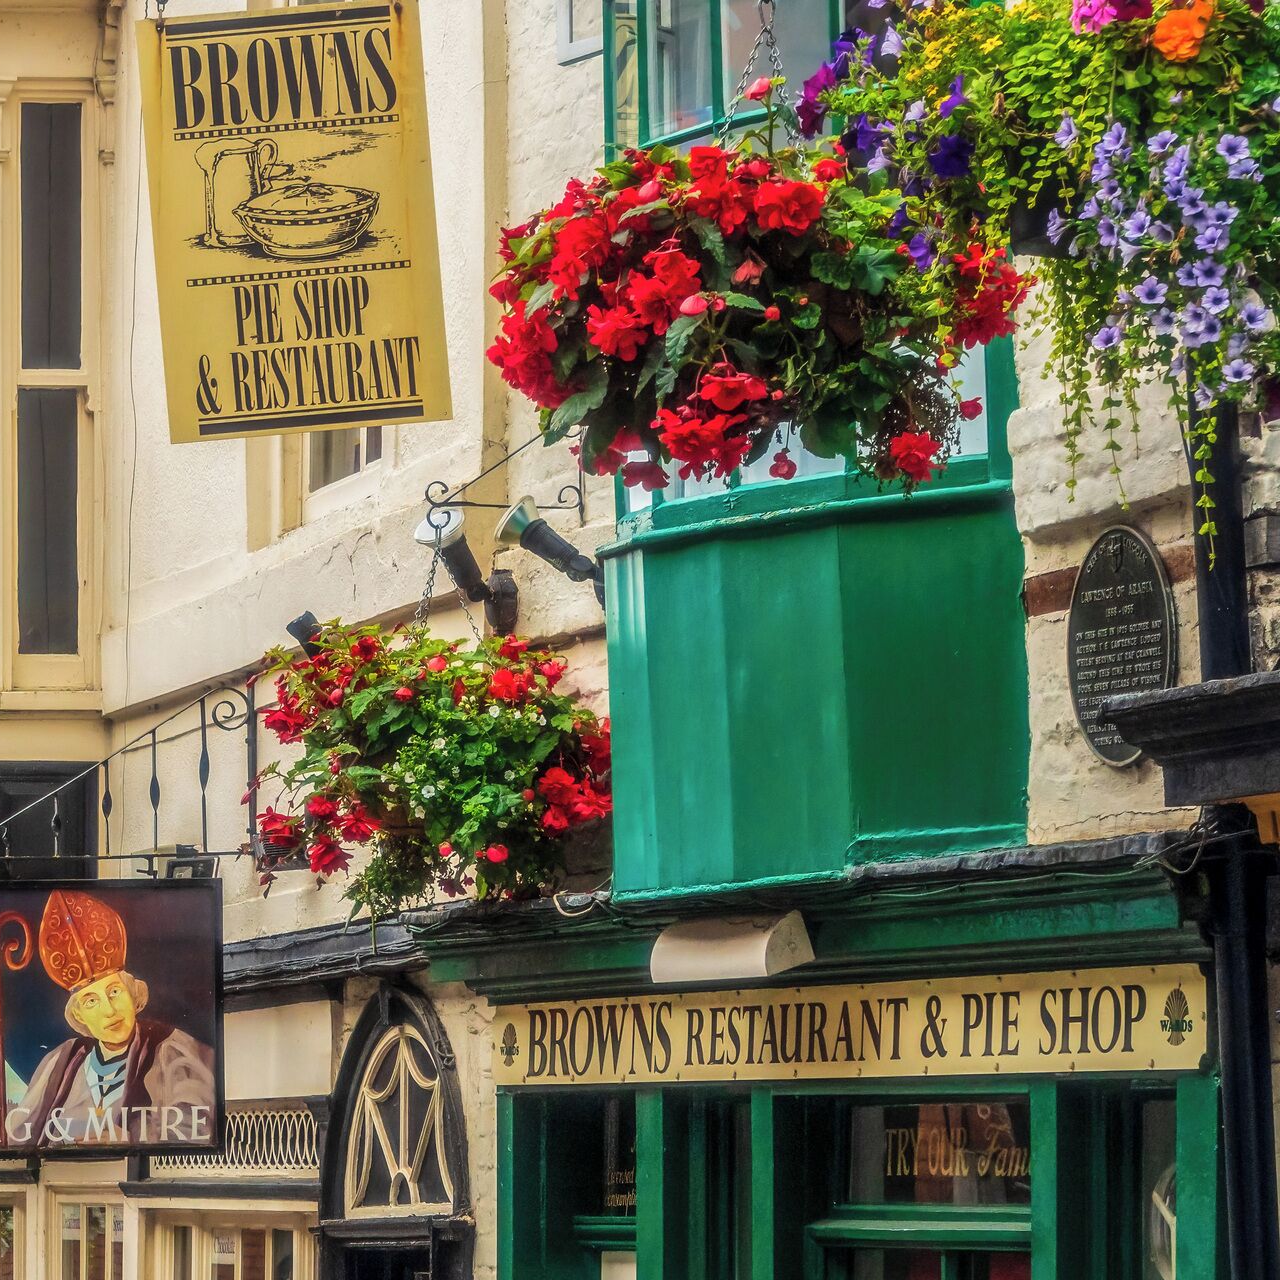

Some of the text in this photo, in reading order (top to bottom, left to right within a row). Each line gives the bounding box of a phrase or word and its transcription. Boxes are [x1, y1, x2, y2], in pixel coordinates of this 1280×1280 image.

[168, 27, 397, 130] BROWNS
[234, 276, 370, 347] PIE SHOP
[195, 336, 421, 416] & RESTAURANT
[1080, 587, 1114, 604] LAWRENCE
[1115, 585, 1125, 598] OF
[526, 984, 1147, 1078] BROWNS RESTAURANT & PIE SHOP
[45, 1107, 76, 1143] &
[83, 1105, 212, 1143] MITRE
[886, 1127, 970, 1177] TRY OUR
